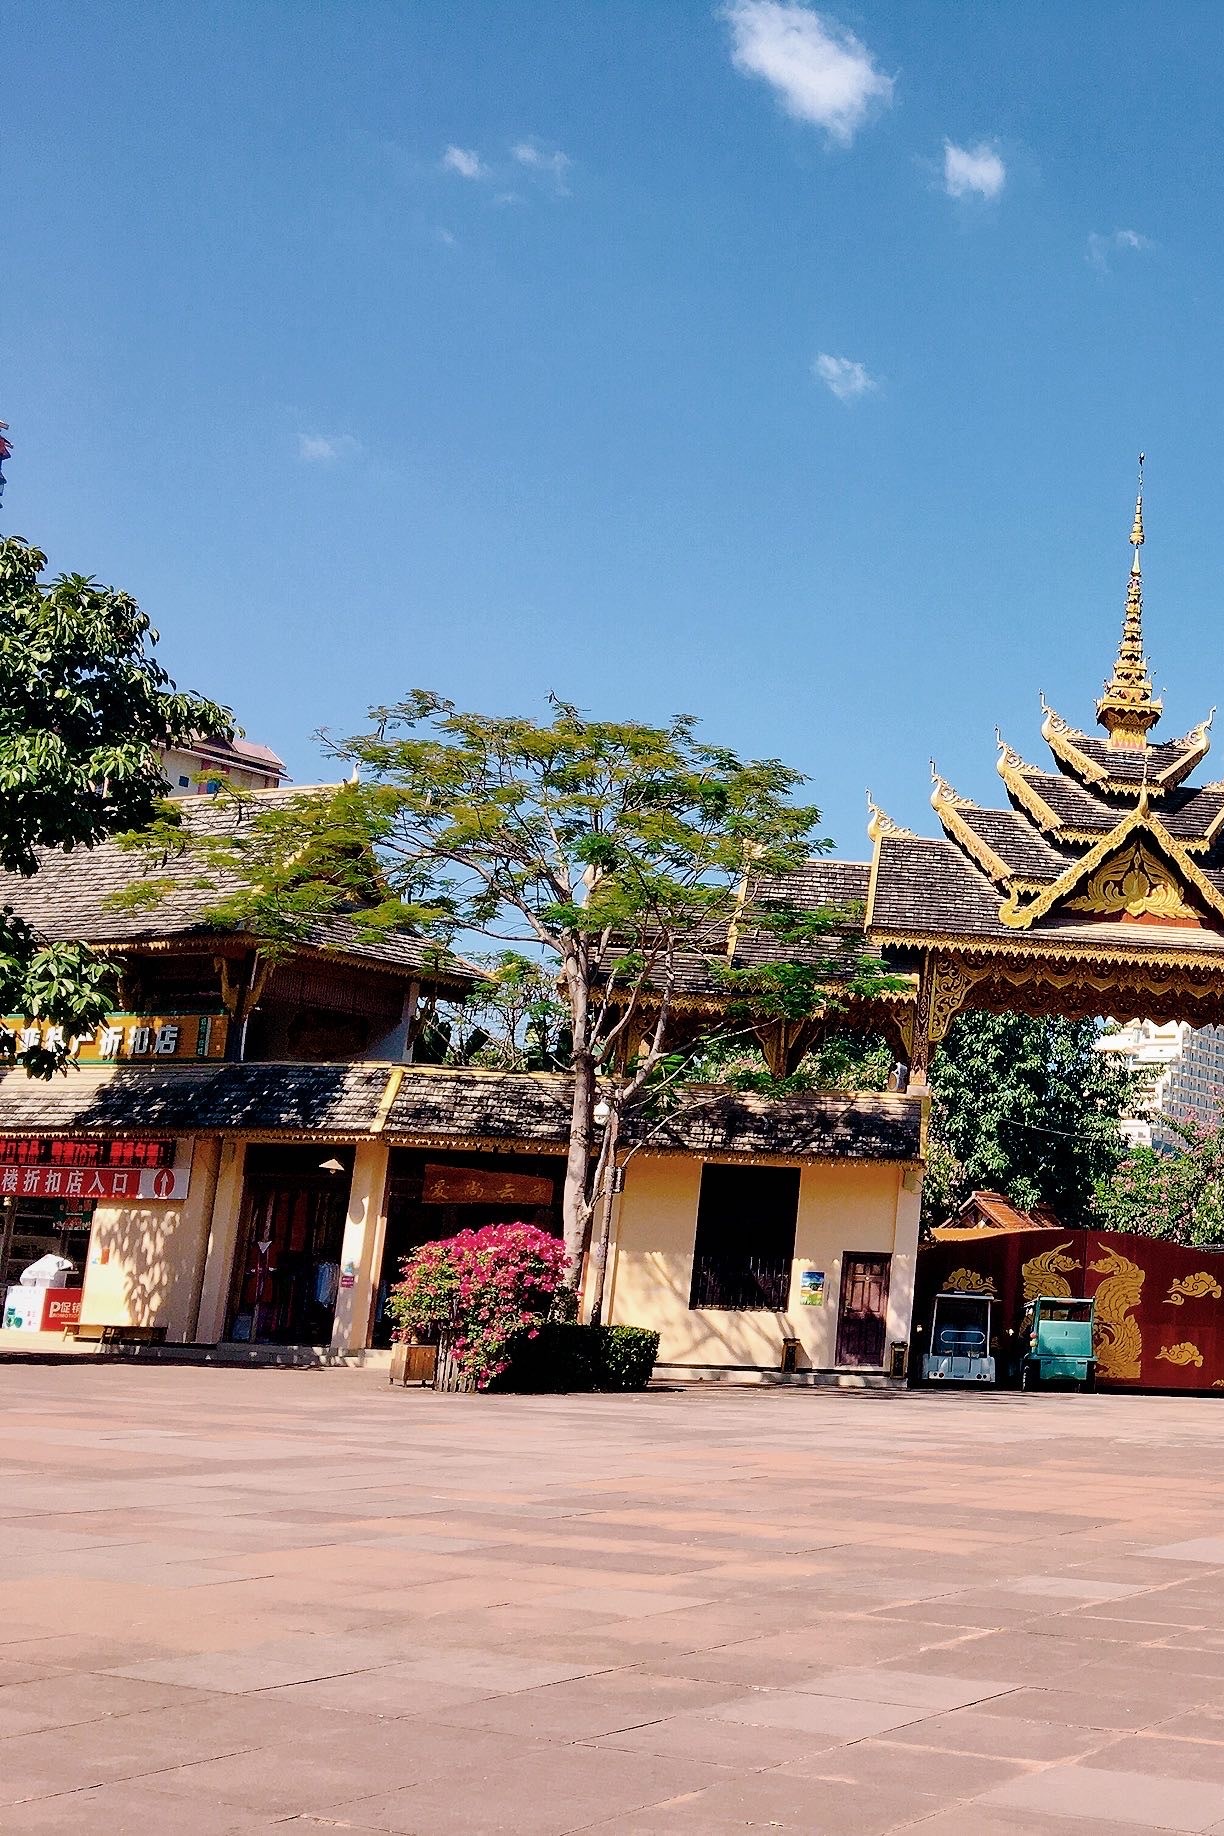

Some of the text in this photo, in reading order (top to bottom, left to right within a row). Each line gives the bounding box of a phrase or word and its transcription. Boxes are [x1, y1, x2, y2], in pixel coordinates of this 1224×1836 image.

[1, 1168, 128, 1194] 楼折扣店入口
